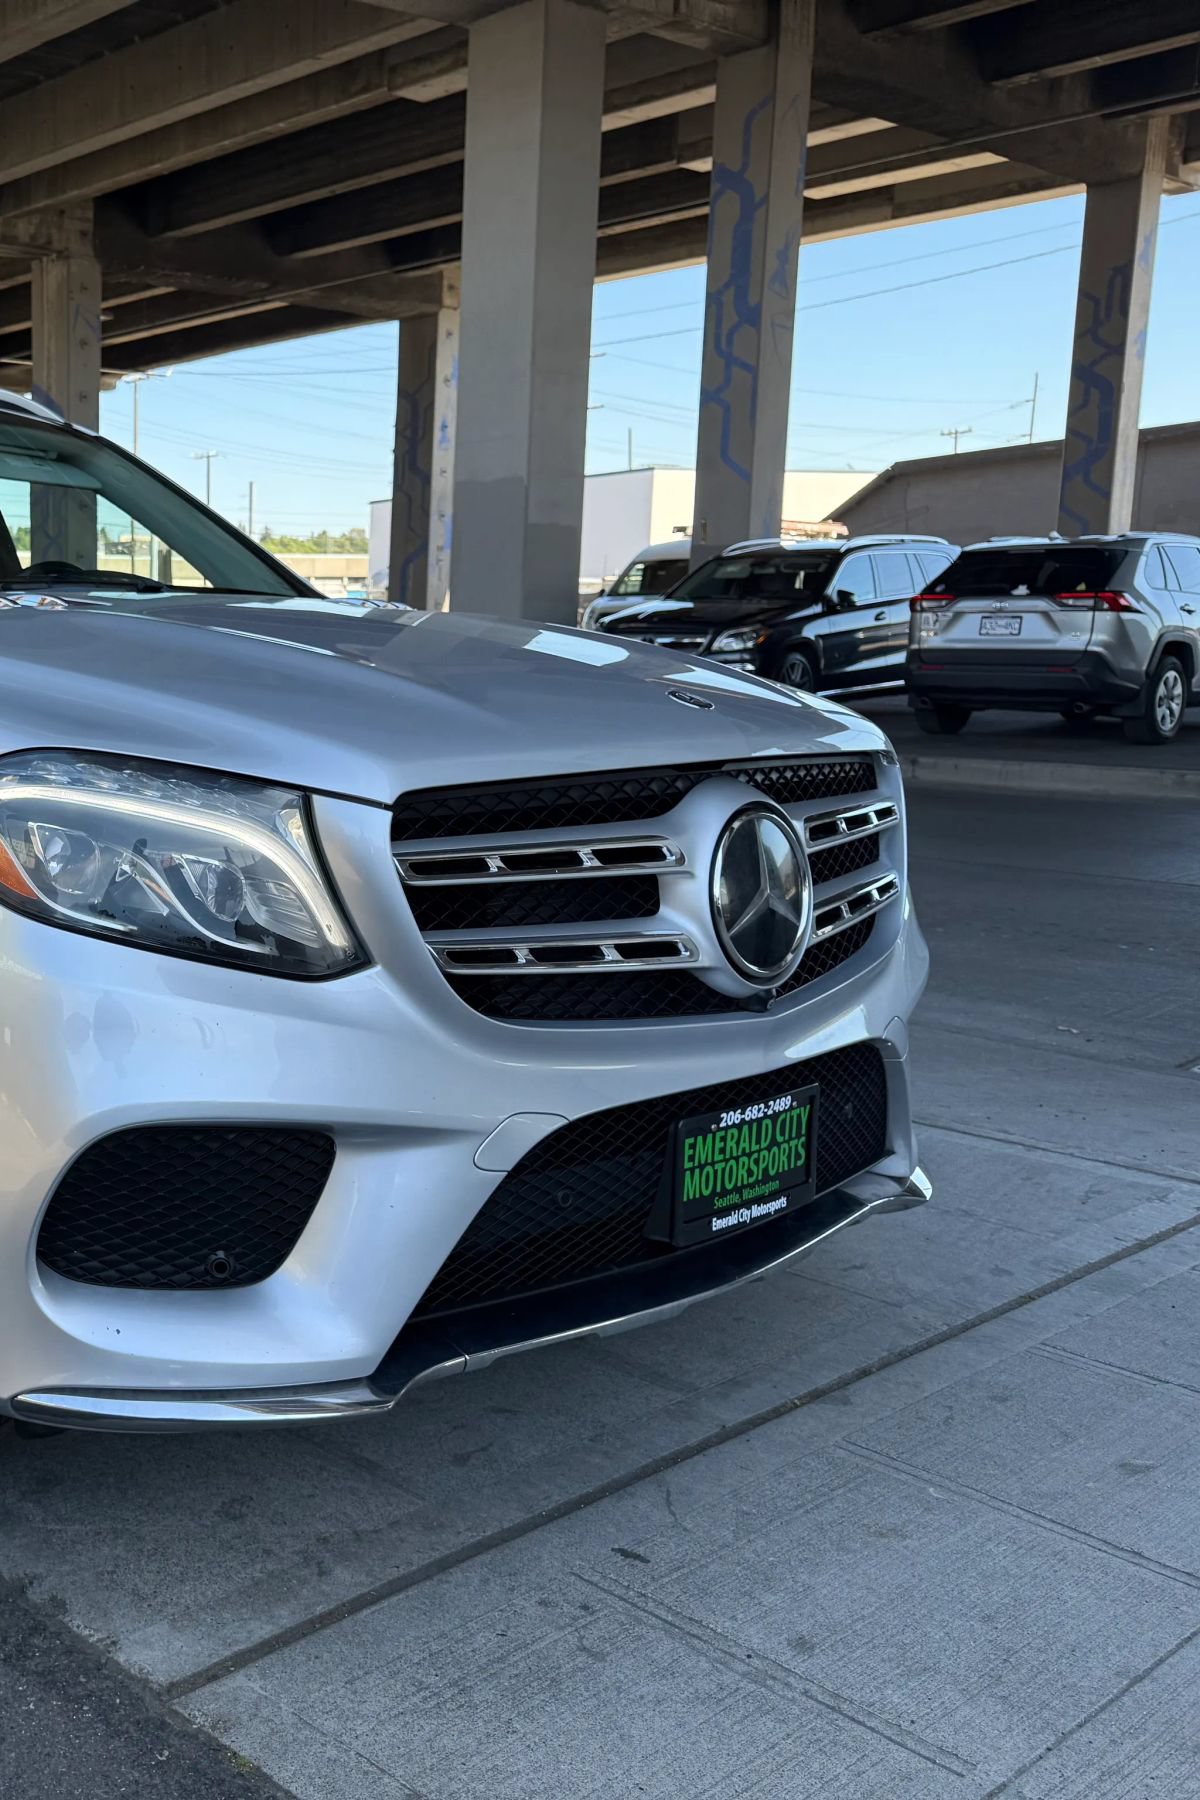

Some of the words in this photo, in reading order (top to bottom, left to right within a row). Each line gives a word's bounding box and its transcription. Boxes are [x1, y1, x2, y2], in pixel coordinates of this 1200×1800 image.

[719, 1095, 792, 1128] 206-682-2489
[684, 1118, 772, 1168] EMERALD
[776, 1104, 811, 1142] CITY
[683, 1136, 806, 1201] MOTORSPORTS
[713, 1190, 741, 1209] Seattle,
[742, 1180, 779, 1201] Washington
[712, 1210, 738, 1231] Emerald
[738, 1208, 751, 1223] City
[751, 1195, 787, 1219] Motorsports
